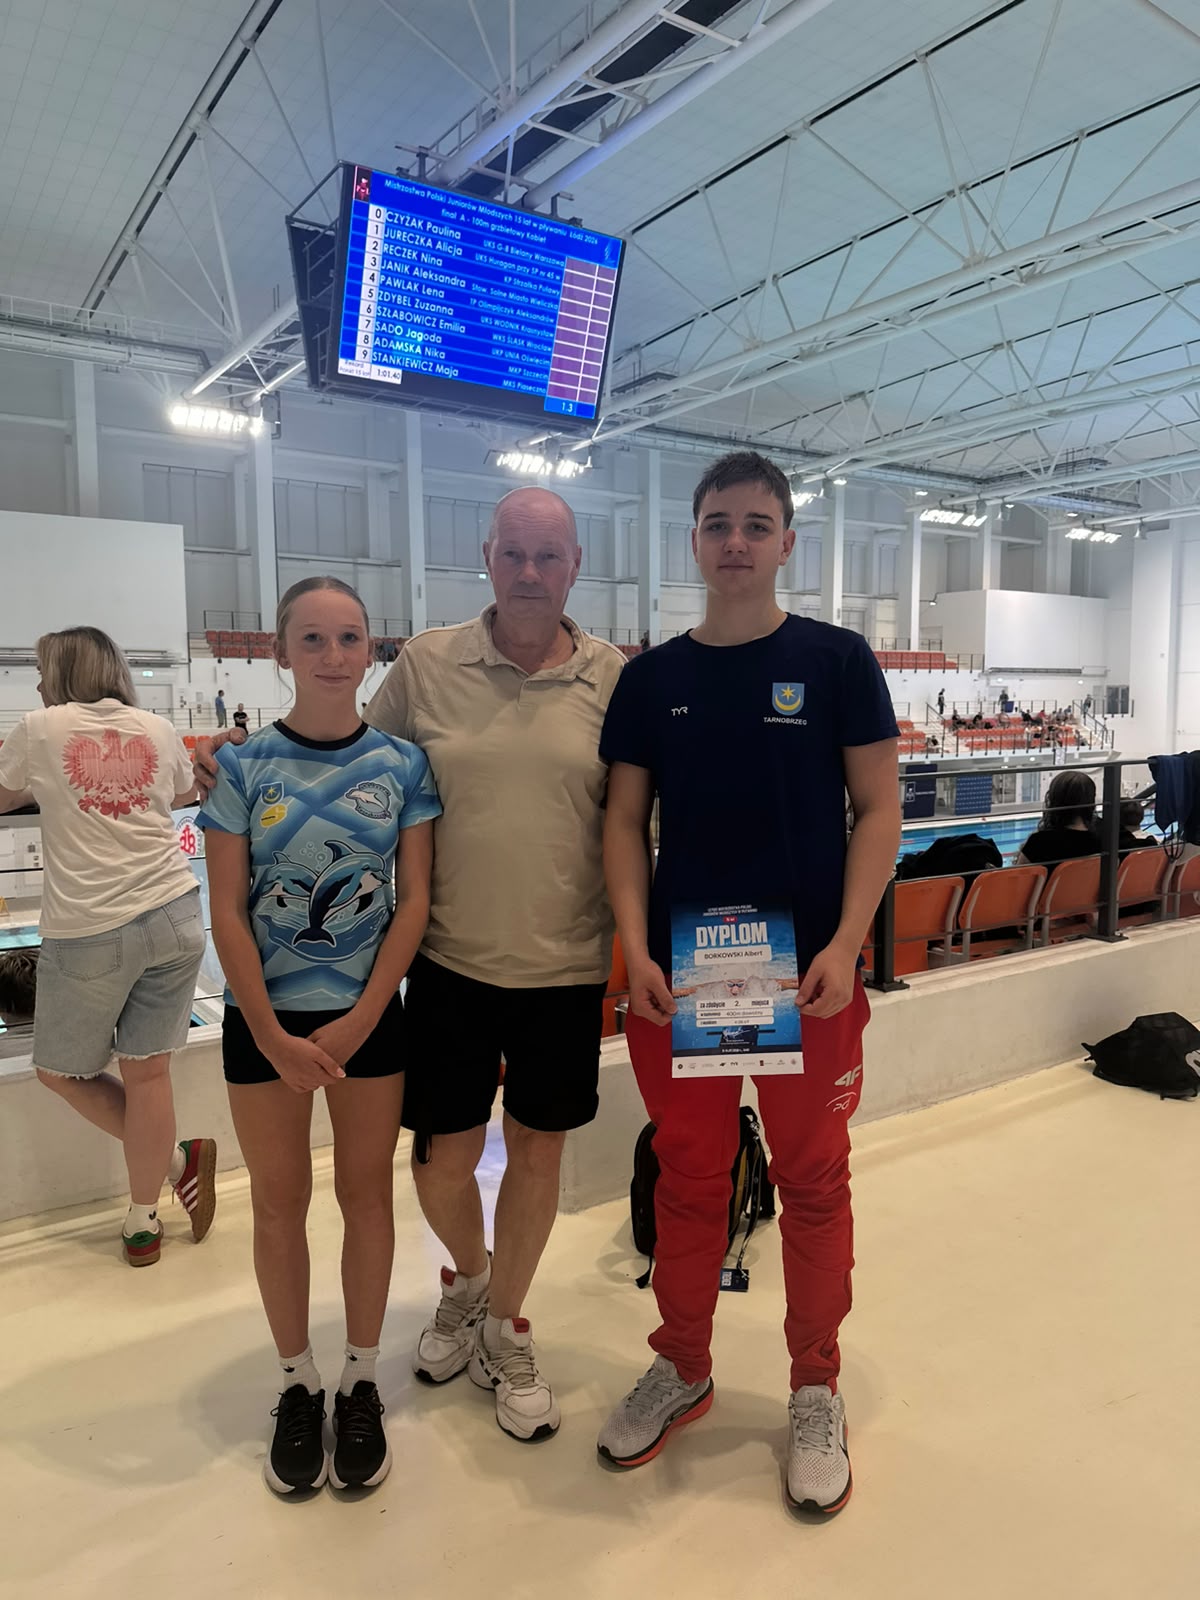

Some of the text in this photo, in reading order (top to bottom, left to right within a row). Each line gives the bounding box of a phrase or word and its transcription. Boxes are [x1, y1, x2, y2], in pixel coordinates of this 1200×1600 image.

[384, 178, 425, 197] Mistrzostwa
[426, 190, 446, 203] Polski
[447, 196, 477, 211] Juniorów
[477, 204, 512, 222] Młodszych
[514, 215, 521, 224] 15
[522, 217, 531, 226] lat
[538, 221, 567, 237] pływaniu
[569, 229, 583, 240] Łódź
[459, 213, 465, 222] A
[471, 217, 489, 228] 100m
[490, 222, 524, 239] grzbietowy
[526, 231, 546, 243] Kobiet
[374, 224, 378, 234] 1
[384, 226, 433, 248] JURECZKA
[435, 239, 463, 258] Alicja
[475, 253, 487, 262] UKS
[488, 256, 515, 271] Huragan
[516, 264, 529, 274] przy
[531, 267, 538, 275] SP
[546, 270, 554, 279] 45
[375, 207, 381, 218] 0
[385, 208, 424, 230] CZYŻAK
[426, 221, 461, 239] Paulina
[483, 239, 495, 249] UKS
[509, 246, 533, 260] Bielany
[534, 252, 565, 266] Warszawa
[370, 256, 376, 266] 3
[381, 258, 410, 274] JANIK
[412, 266, 466, 287] Aleksandra
[490, 287, 507, 297] Solne
[508, 291, 529, 302] Miasto
[529, 296, 558, 309] Wieliczka
[372, 240, 378, 250] 2
[382, 242, 418, 260] RECZEK
[420, 252, 442, 266] Nina
[503, 275, 511, 283] KP
[538, 283, 560, 296] Puławy
[367, 288, 373, 298] 5
[378, 290, 411, 306] ZDYBEL
[414, 298, 453, 315] Zuzanna
[480, 315, 492, 324] UKS
[493, 318, 519, 330] WODNIK
[369, 271, 375, 282] 4
[379, 274, 419, 292] PAWLAK
[422, 284, 444, 298] Lena
[477, 300, 514, 316] Olimpijczyk
[515, 308, 554, 323] Aleksandrów
[365, 319, 370, 329] 7
[374, 321, 403, 336] SADO
[405, 327, 442, 346] Jagoda
[491, 348, 503, 356] UKP
[504, 350, 520, 360] UNIA
[366, 304, 371, 313] 6
[376, 305, 436, 327] SZŁABOWICZ
[438, 319, 465, 333] Emilia
[492, 333, 505, 342] WKS
[526, 340, 551, 352] Wrocław
[362, 349, 546, 394] 9 STANKIEWICZ Maja MKS Piaseczno
[363, 334, 369, 344] 8
[373, 336, 422, 354] ADAMSKA
[424, 346, 446, 359] Nika
[507, 365, 521, 374] MKP
[561, 401, 573, 413] 1.3
[671, 706, 688, 716] TYR
[763, 717, 807, 725] TARNOBRZEG
[696, 921, 768, 947] DYPLOM
